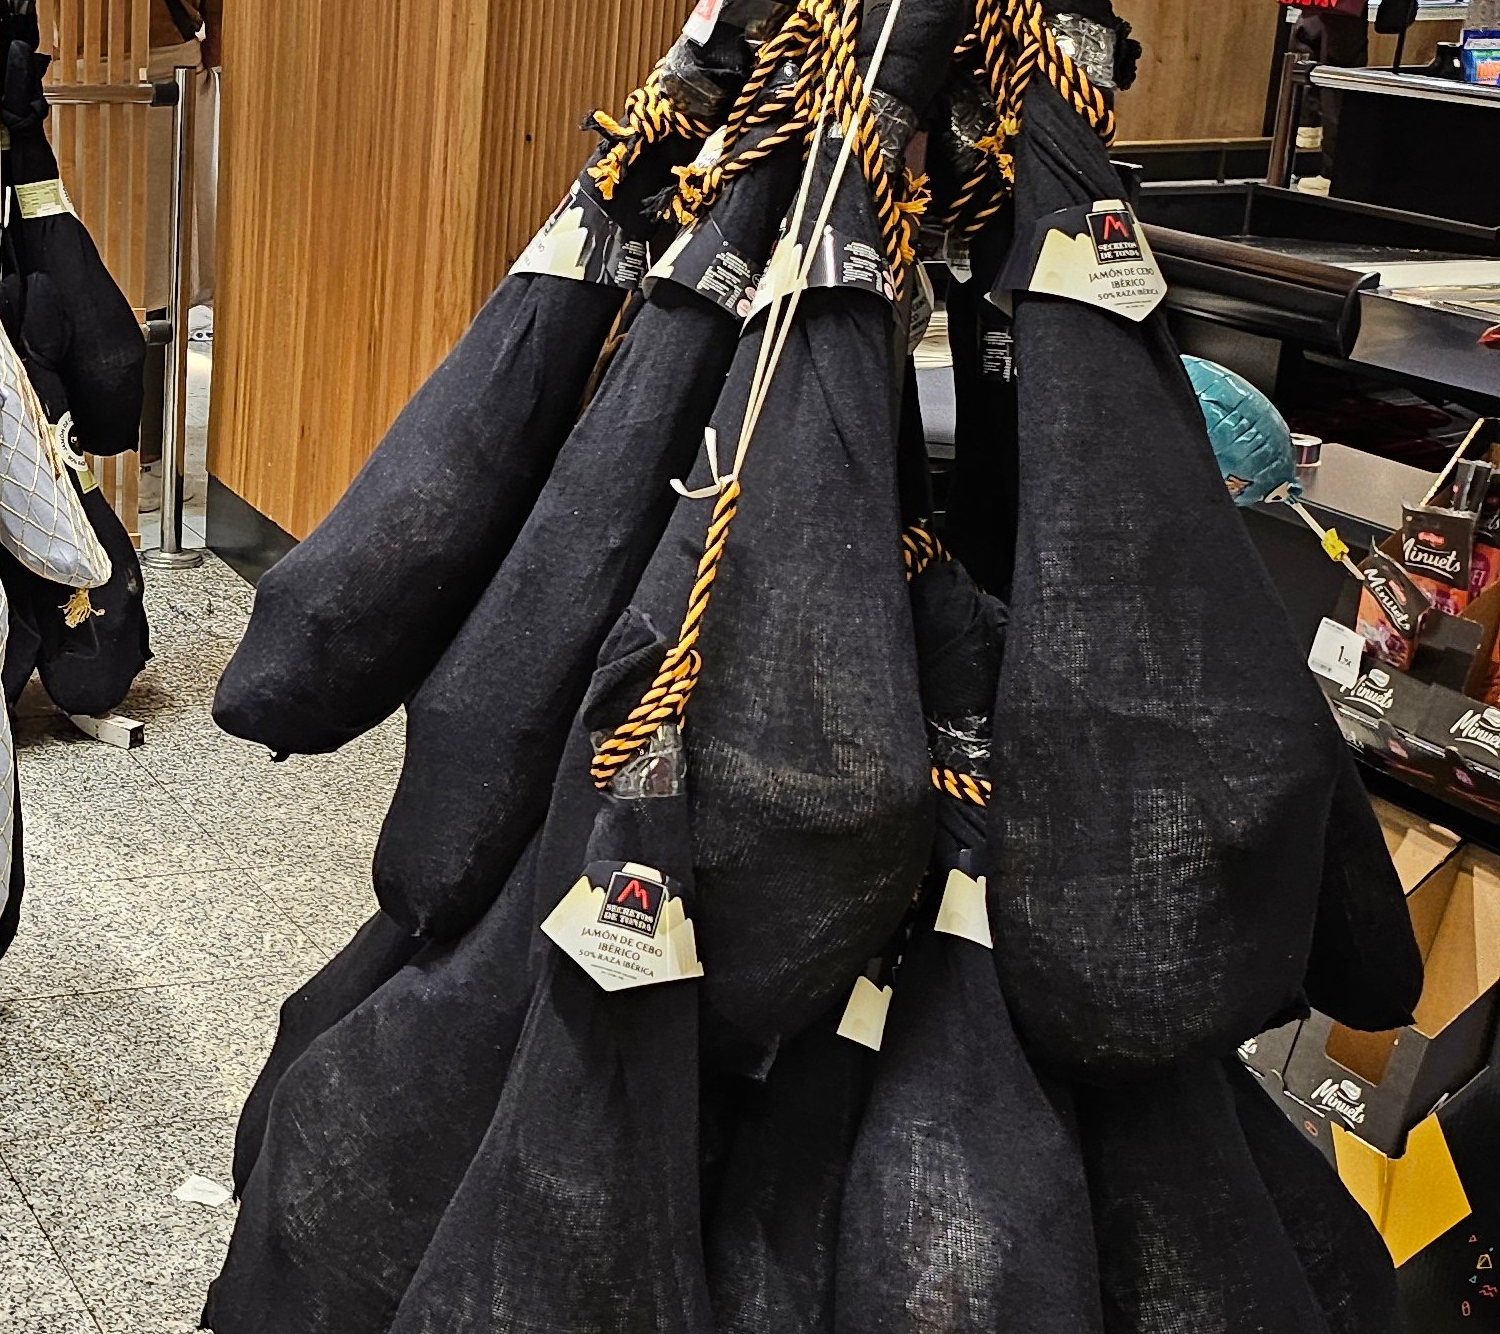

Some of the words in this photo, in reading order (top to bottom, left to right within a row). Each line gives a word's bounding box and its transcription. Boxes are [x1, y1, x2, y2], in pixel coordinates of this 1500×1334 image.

[1098, 241, 1137, 252] SECRETOS
[1100, 251, 1113, 260] DE
[1089, 267, 1124, 284] JAMÓN
[1125, 267, 1135, 277] DE
[1136, 267, 1155, 277] CEBO
[1111, 278, 1146, 290] IBÉRICO
[1098, 292, 1115, 301] 50%
[1116, 290, 1137, 298] RAZA
[1363, 568, 1411, 631] Minuets
[603, 911, 618, 922] DE
[606, 903, 654, 924] SECRETOS
[581, 927, 618, 942] JAMÓN
[620, 936, 633, 948] DE
[635, 941, 663, 958] CEBO
[598, 942, 641, 961] IBÉRICO
[579, 948, 596, 959] 50%
[597, 953, 621, 966] RAZA
[622, 960, 654, 978] IBÉRICA
[1311, 1078, 1366, 1125] Minuets
